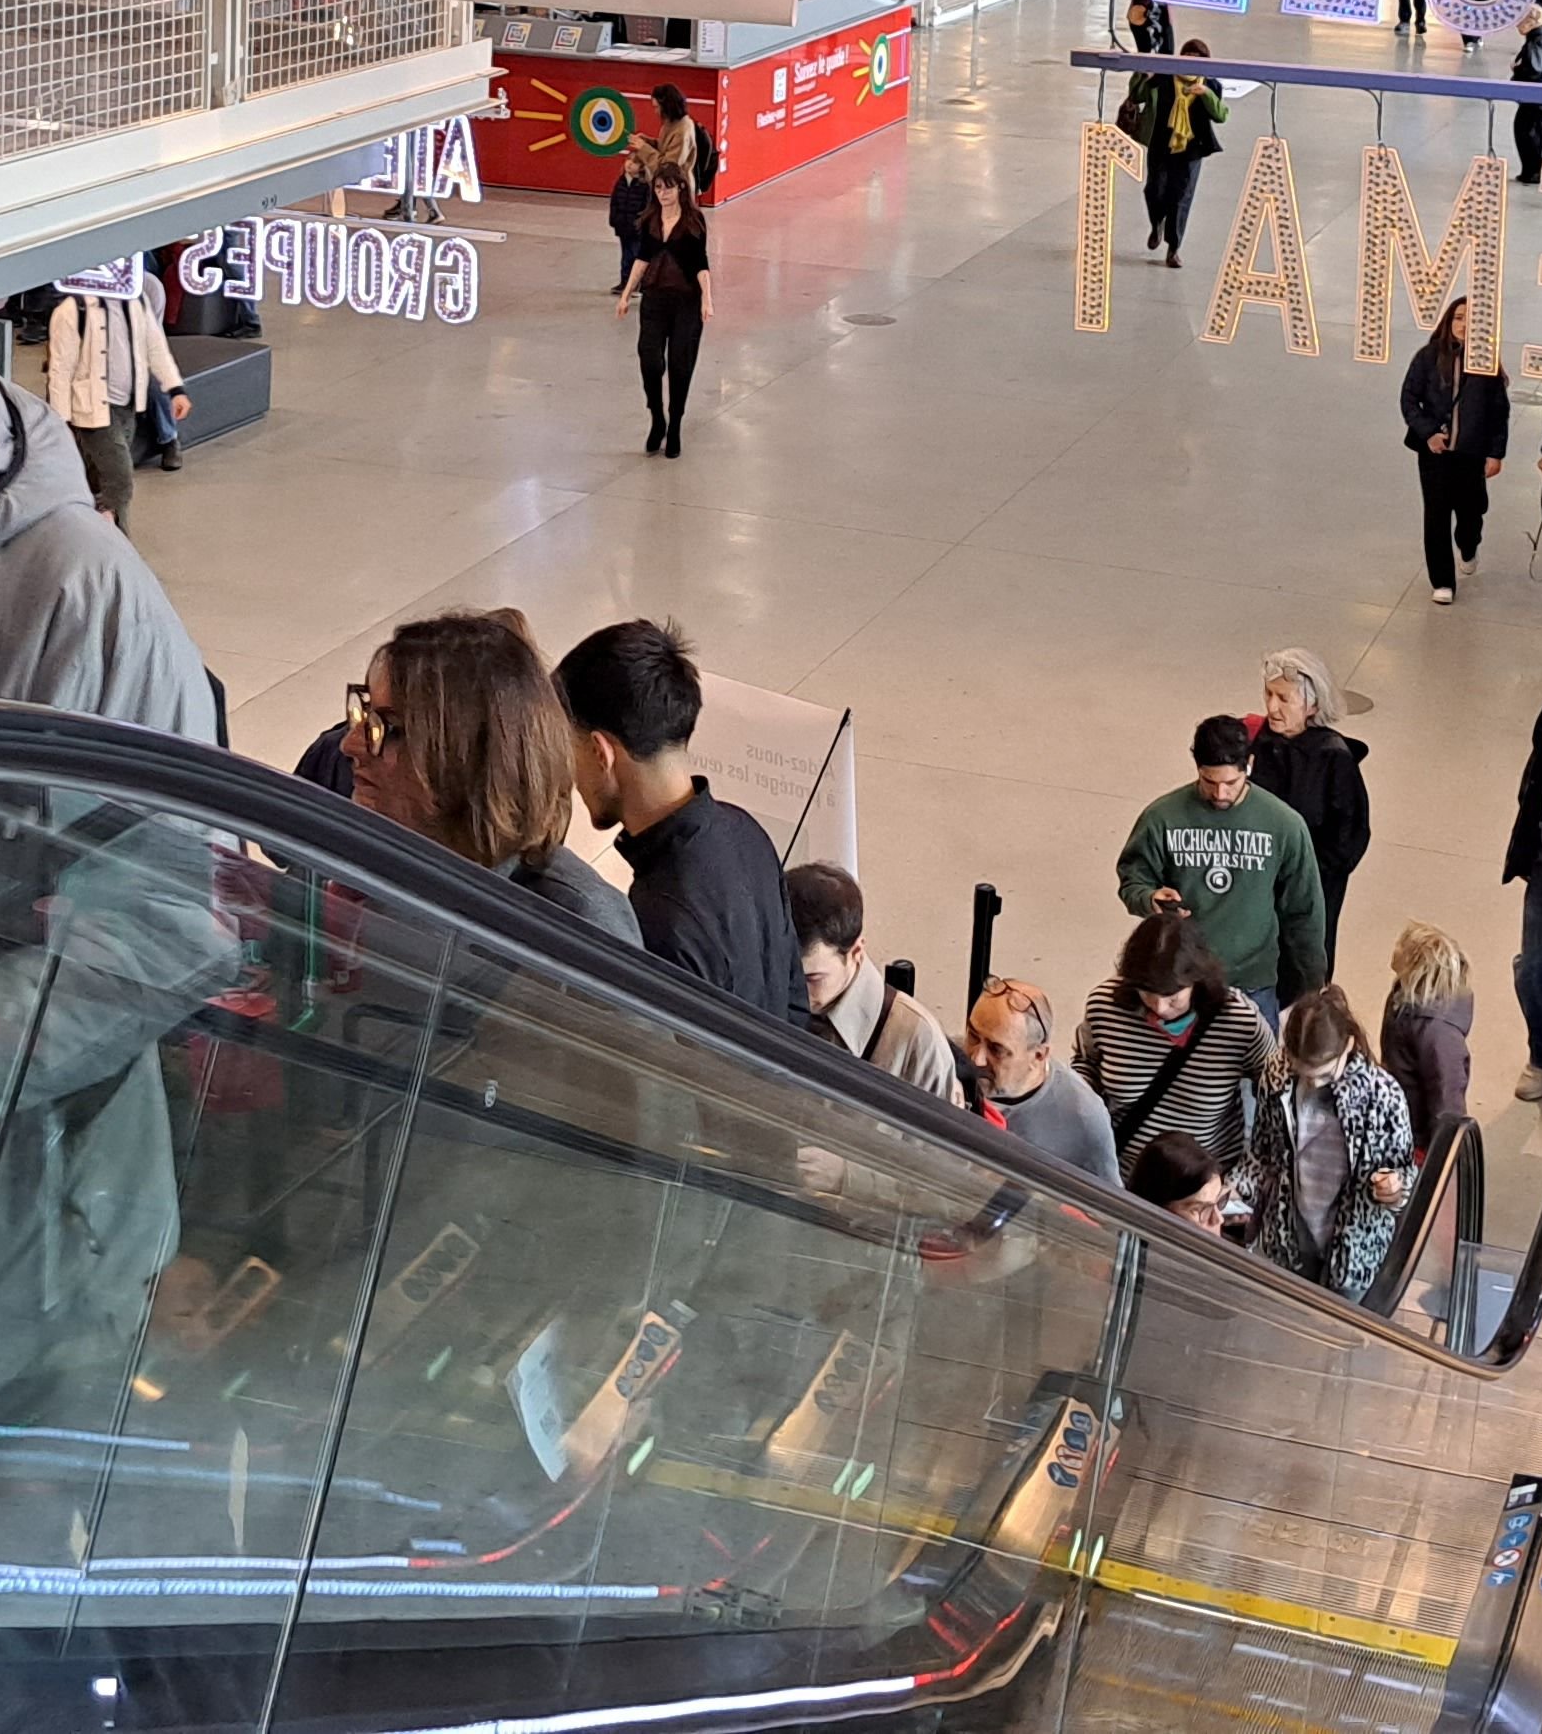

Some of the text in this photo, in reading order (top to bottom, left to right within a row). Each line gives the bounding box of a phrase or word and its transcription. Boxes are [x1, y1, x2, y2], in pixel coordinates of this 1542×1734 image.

[1166, 828, 1273, 856] MICHIGAN STATE
[1173, 852, 1265, 871] UNIVERSITY
